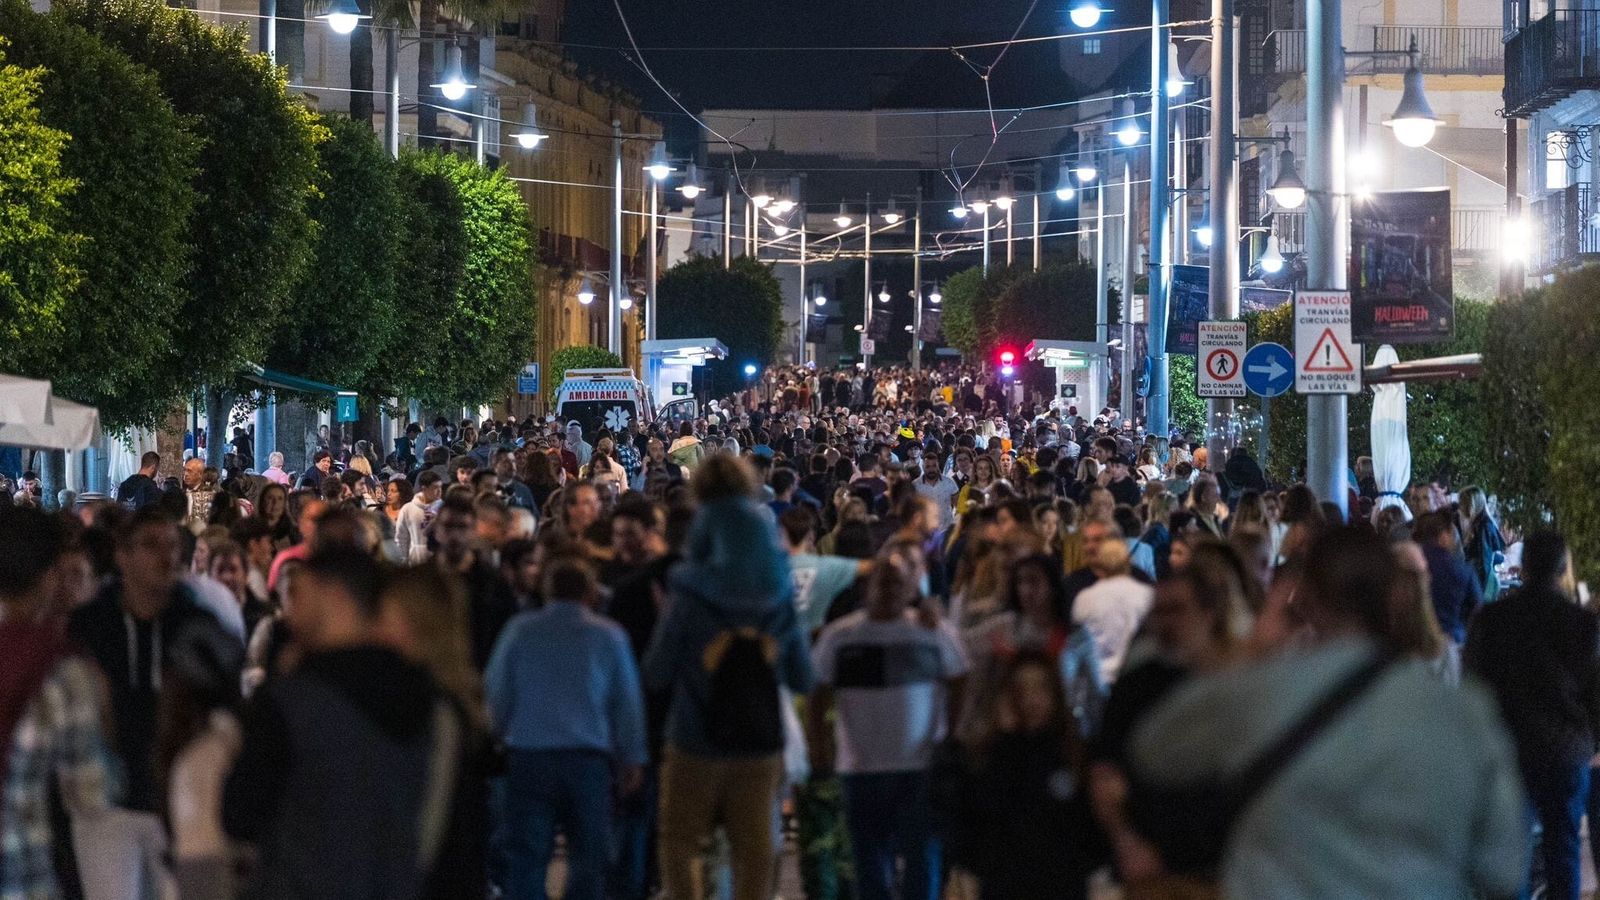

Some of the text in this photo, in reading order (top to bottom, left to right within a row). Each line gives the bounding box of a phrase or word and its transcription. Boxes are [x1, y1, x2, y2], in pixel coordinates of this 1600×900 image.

[1299, 294, 1350, 304] ATENCIÓ
[1307, 307, 1349, 315] TRANVÍAS
[1374, 304, 1429, 322] HALLOWEEN
[1200, 323, 1245, 331] ATENCIÓN
[1328, 382, 1348, 390] VÍAS
[569, 390, 628, 400] AMBULANCIA
